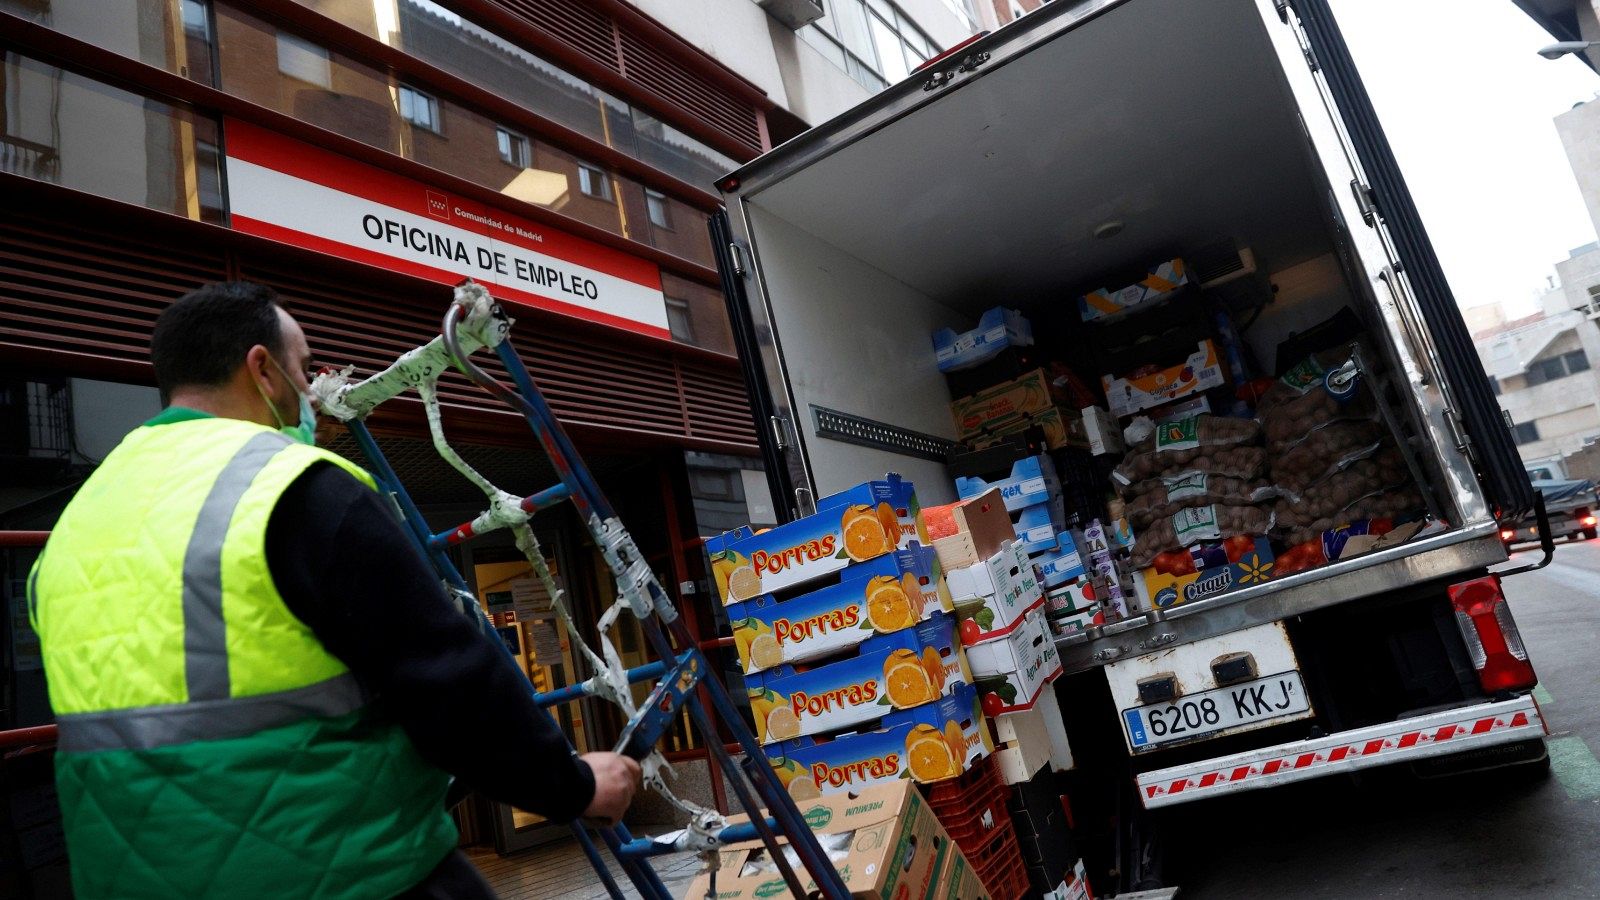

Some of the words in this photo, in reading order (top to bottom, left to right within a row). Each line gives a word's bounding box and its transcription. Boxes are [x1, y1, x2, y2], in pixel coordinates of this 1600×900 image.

[454, 207, 503, 230] Comunidad
[504, 222, 515, 234] de
[516, 226, 543, 243] Madrid
[362, 214, 472, 266] OFICINA
[477, 246, 509, 276] DE
[516, 258, 599, 300] EMPLEO
[751, 534, 836, 578] Porras
[1183, 567, 1233, 601] Cuqui
[773, 603, 860, 647] Porras
[790, 679, 878, 722] Porras
[1149, 698, 1220, 737] 6208
[1231, 680, 1291, 719] KKJ
[1135, 731, 1143, 740] E
[810, 752, 899, 792] Porras
[845, 800, 884, 817] PREMIUM
